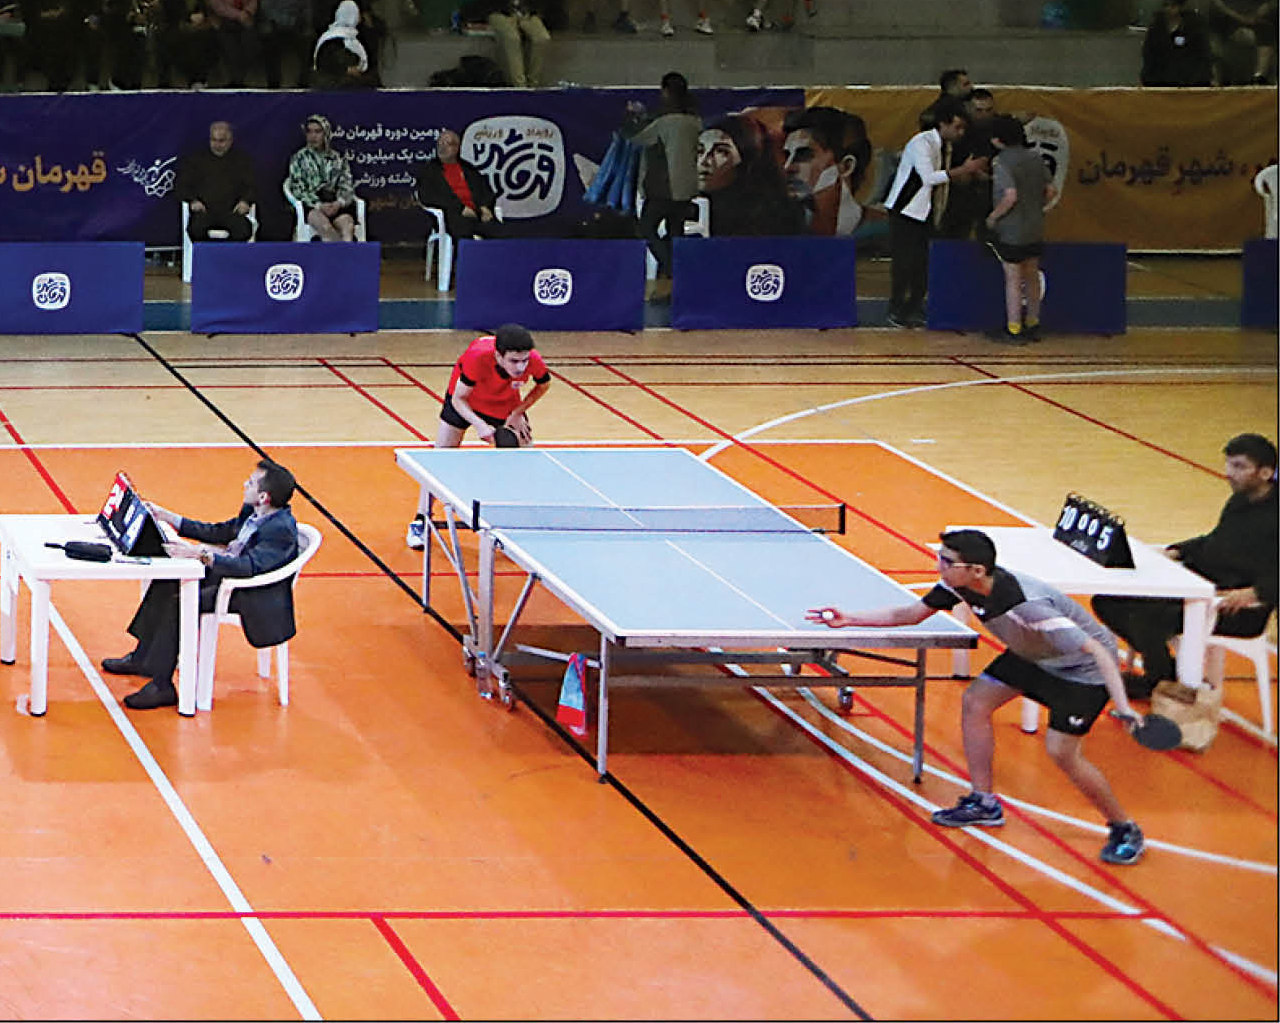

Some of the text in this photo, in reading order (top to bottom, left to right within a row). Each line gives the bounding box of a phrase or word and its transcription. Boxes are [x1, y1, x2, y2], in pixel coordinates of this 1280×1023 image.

[345, 122, 383, 142] قهرمان
[385, 127, 409, 142] دوره
[355, 147, 395, 165] میلیون
[396, 147, 414, 164] یک
[1078, 144, 1171, 186] قهرمان
[12, 151, 107, 193] قهرمان
[387, 170, 417, 187] رشته
[1097, 525, 1114, 551] 5
